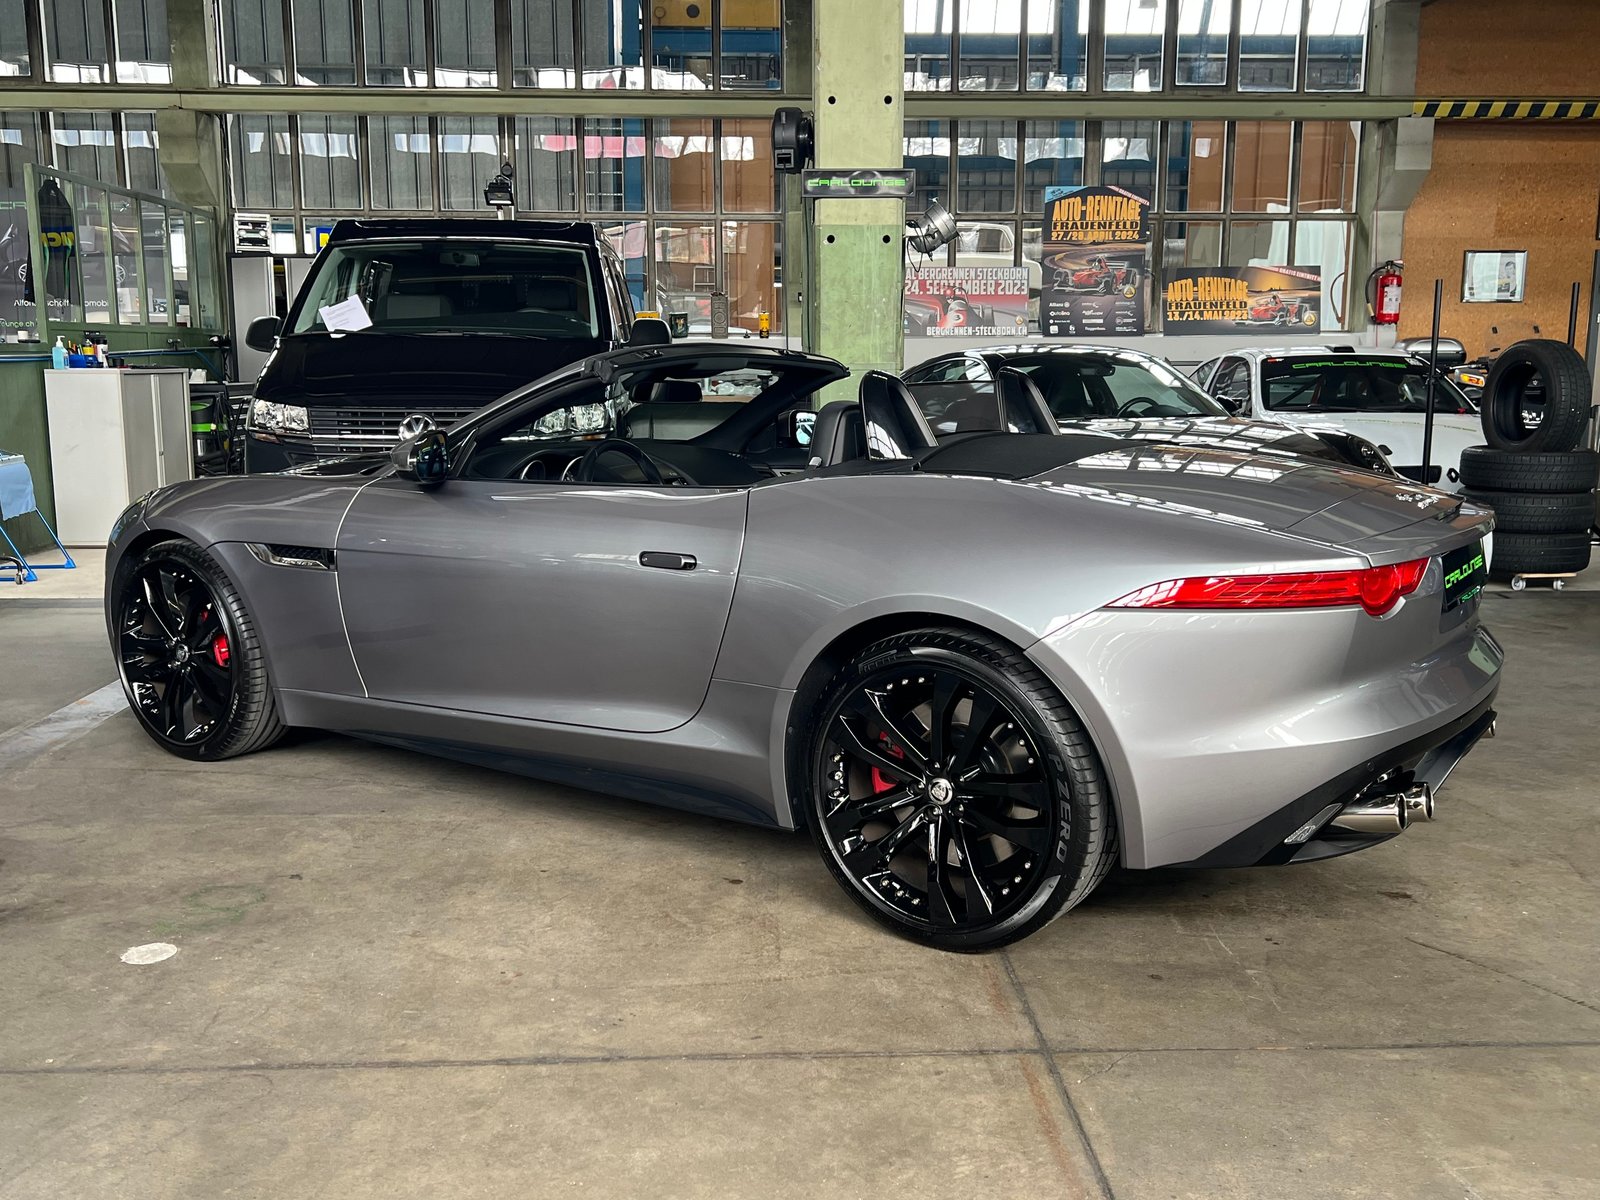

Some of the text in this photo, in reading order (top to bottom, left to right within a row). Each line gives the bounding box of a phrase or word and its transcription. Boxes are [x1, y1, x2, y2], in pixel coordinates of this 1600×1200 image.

[807, 178, 906, 187] CARLOUNGE
[1052, 195, 1141, 221] AUTO-RENNTAGE
[1052, 221, 1140, 230] FRAUENFELD
[1115, 230, 1139, 240] 2024
[905, 268, 1028, 280] AL BERGRENNEN STECKBORN
[997, 281, 1028, 295] 2023
[1167, 276, 1249, 301] AUTO-RENNTAGE
[1168, 301, 1248, 310] FRAUENFELD
[926, 326, 1027, 336] BERGRENNEN-STECKBORN.CH
[1292, 361, 1407, 369] CARLOUNGE
[1056, 778, 1072, 864] ZERO
